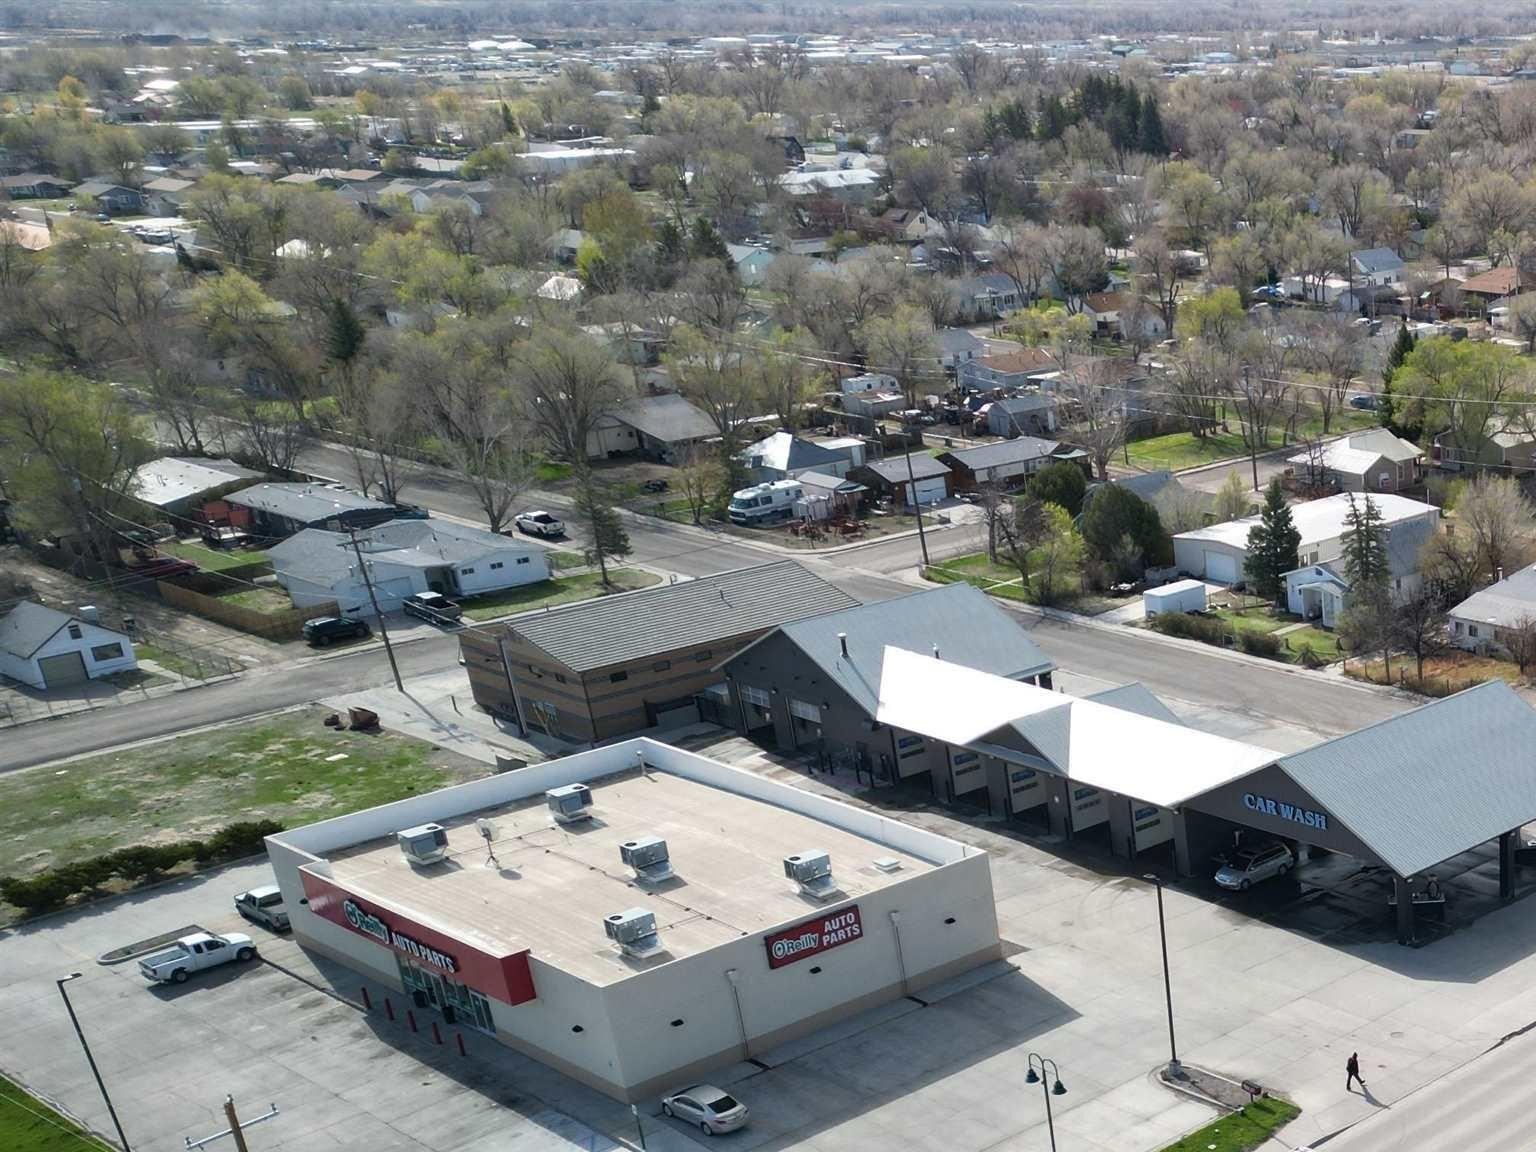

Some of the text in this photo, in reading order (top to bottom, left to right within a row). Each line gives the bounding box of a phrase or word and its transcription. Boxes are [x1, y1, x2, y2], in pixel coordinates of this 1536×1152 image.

[1243, 793, 1327, 830] CAR WASH
[343, 900, 456, 973] O'Reilly AUTO PARTS
[824, 912, 855, 933] AUTO
[773, 923, 860, 959] O'Reilly PARTS
